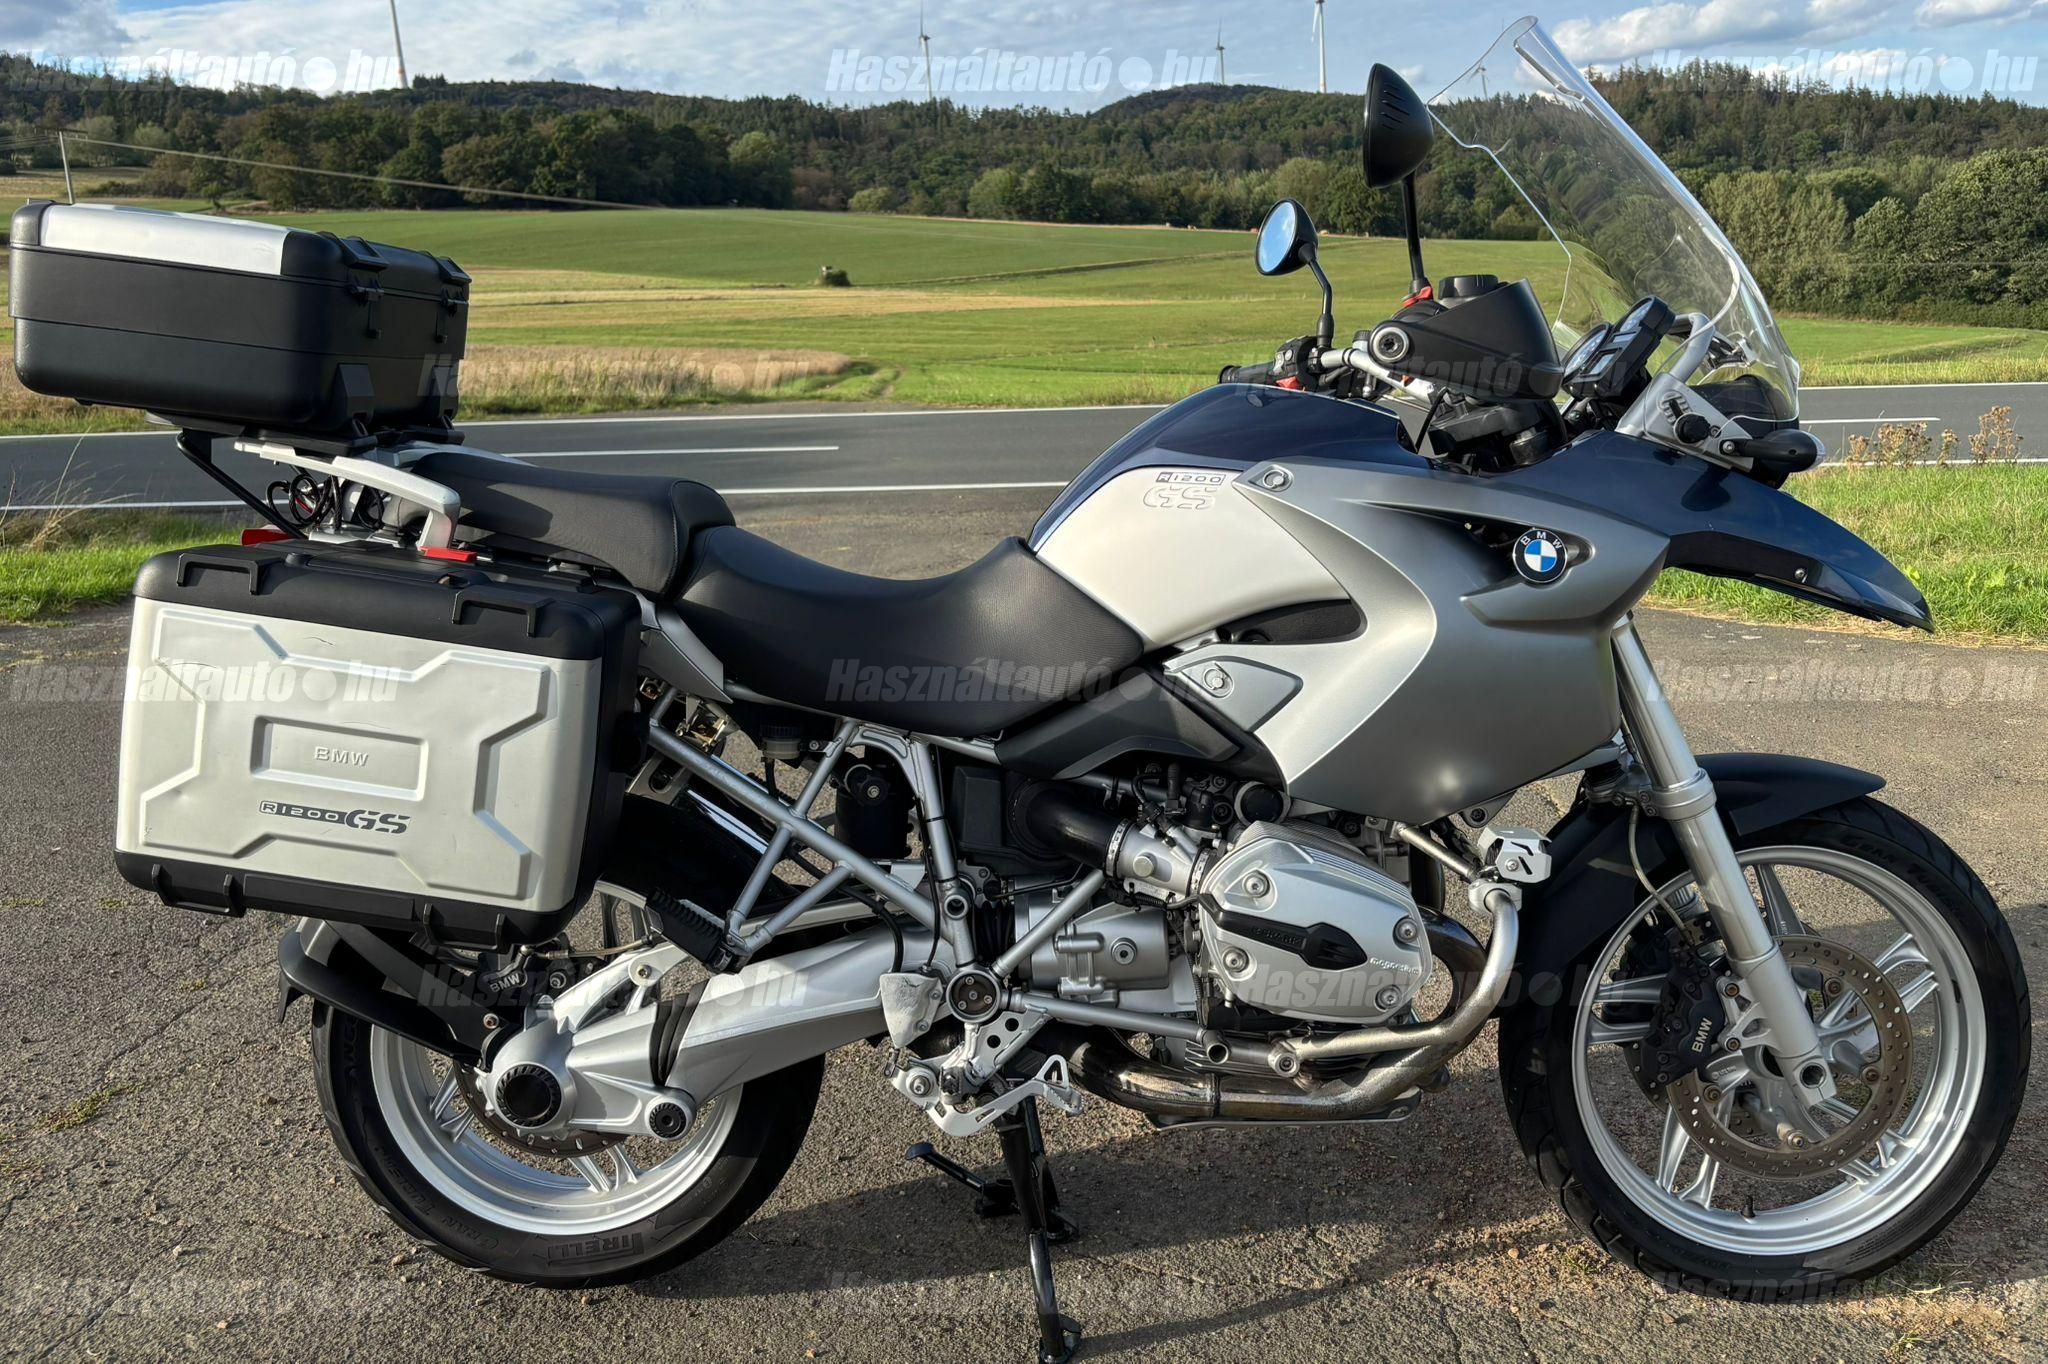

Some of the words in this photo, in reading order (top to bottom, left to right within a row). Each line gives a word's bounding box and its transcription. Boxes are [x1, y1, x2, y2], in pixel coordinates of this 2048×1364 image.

[1143, 486, 1217, 511] GS
[1520, 531, 1563, 549] BMW
[314, 746, 369, 767] BMW
[490, 972, 520, 993] BMW
[1691, 1017, 1713, 1053] BMW
